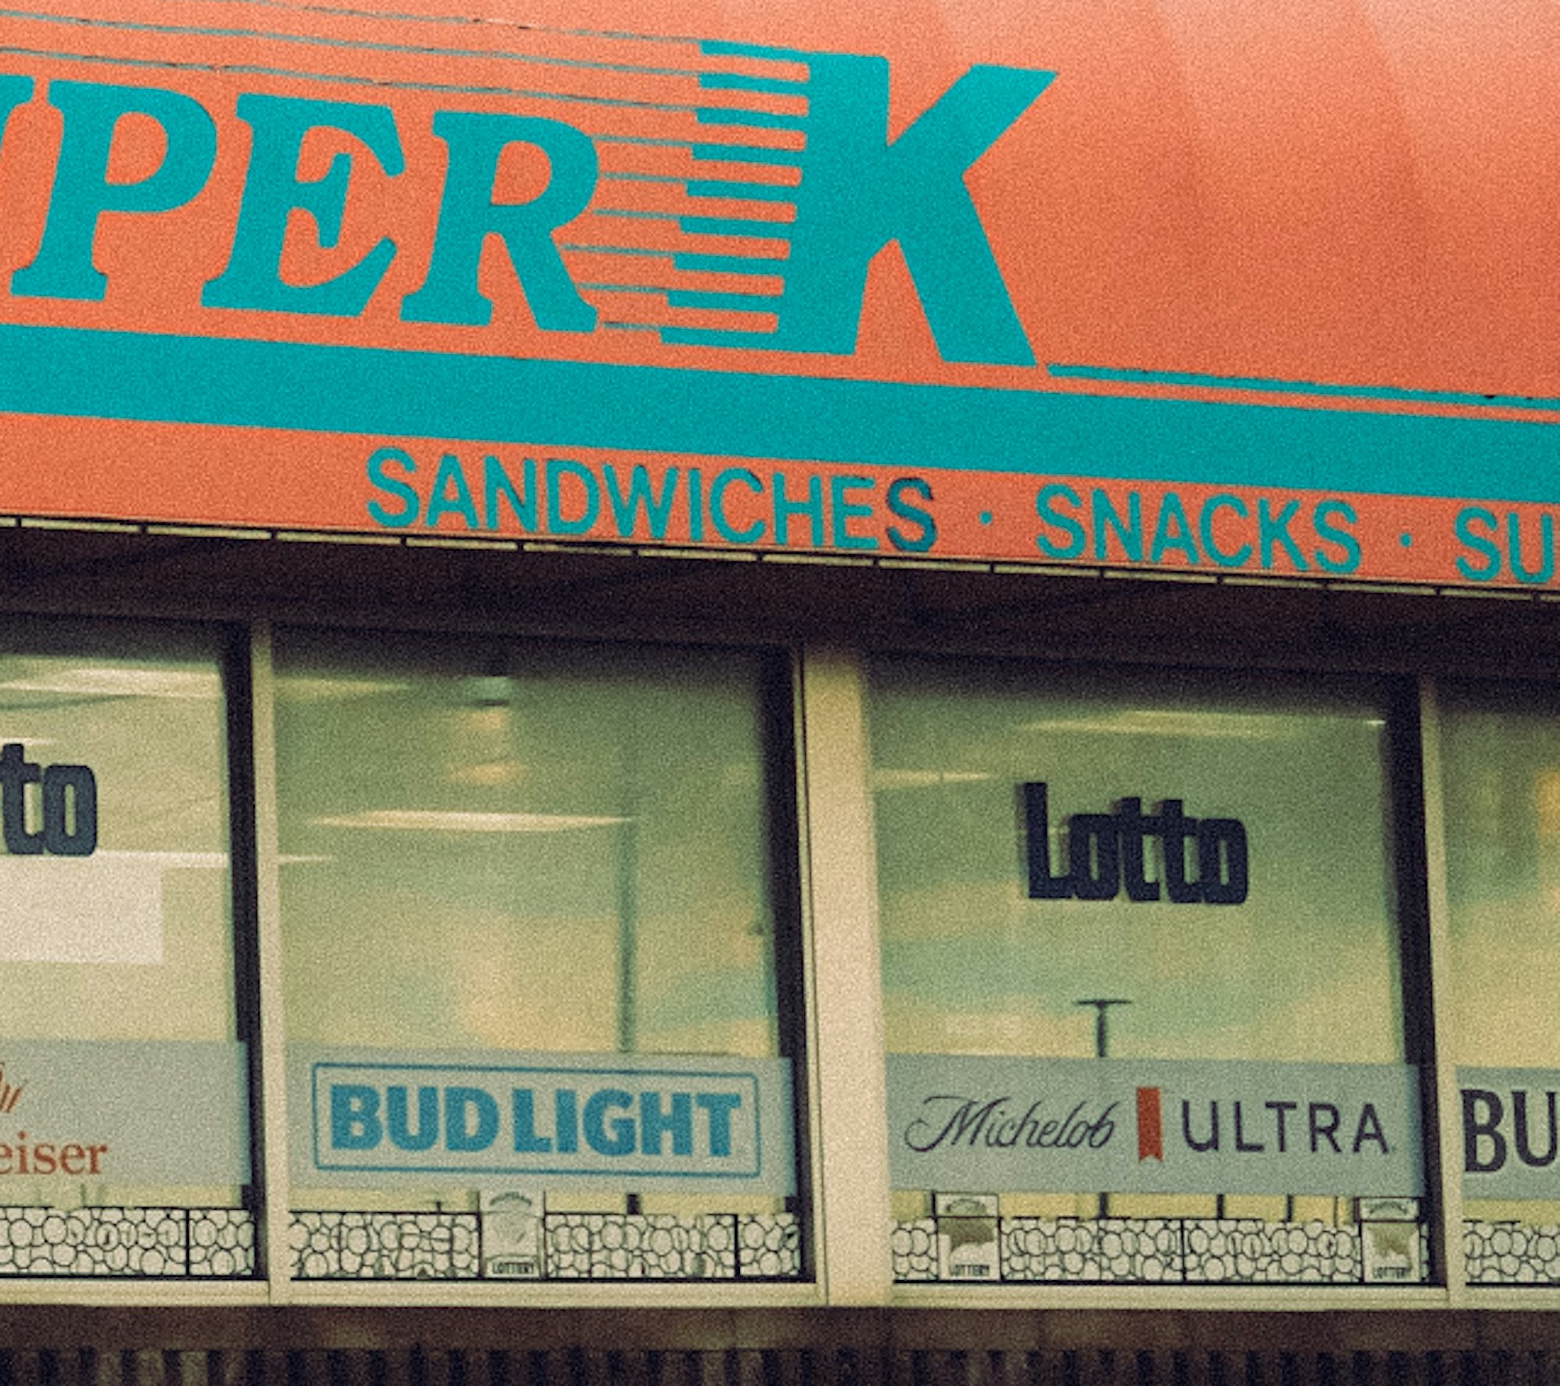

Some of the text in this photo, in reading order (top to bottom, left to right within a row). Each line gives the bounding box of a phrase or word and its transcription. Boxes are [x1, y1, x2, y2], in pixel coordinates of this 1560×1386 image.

[658, 40, 1056, 367] K
[366, 447, 1555, 585] SANDWICHES SNACKS SU
[1022, 780, 1250, 906] Lotto
[330, 1084, 742, 1157] BUD LIGHT
[904, 1093, 1389, 1154] Michelob ULTRA
[1460, 1089, 1559, 1172] BU
